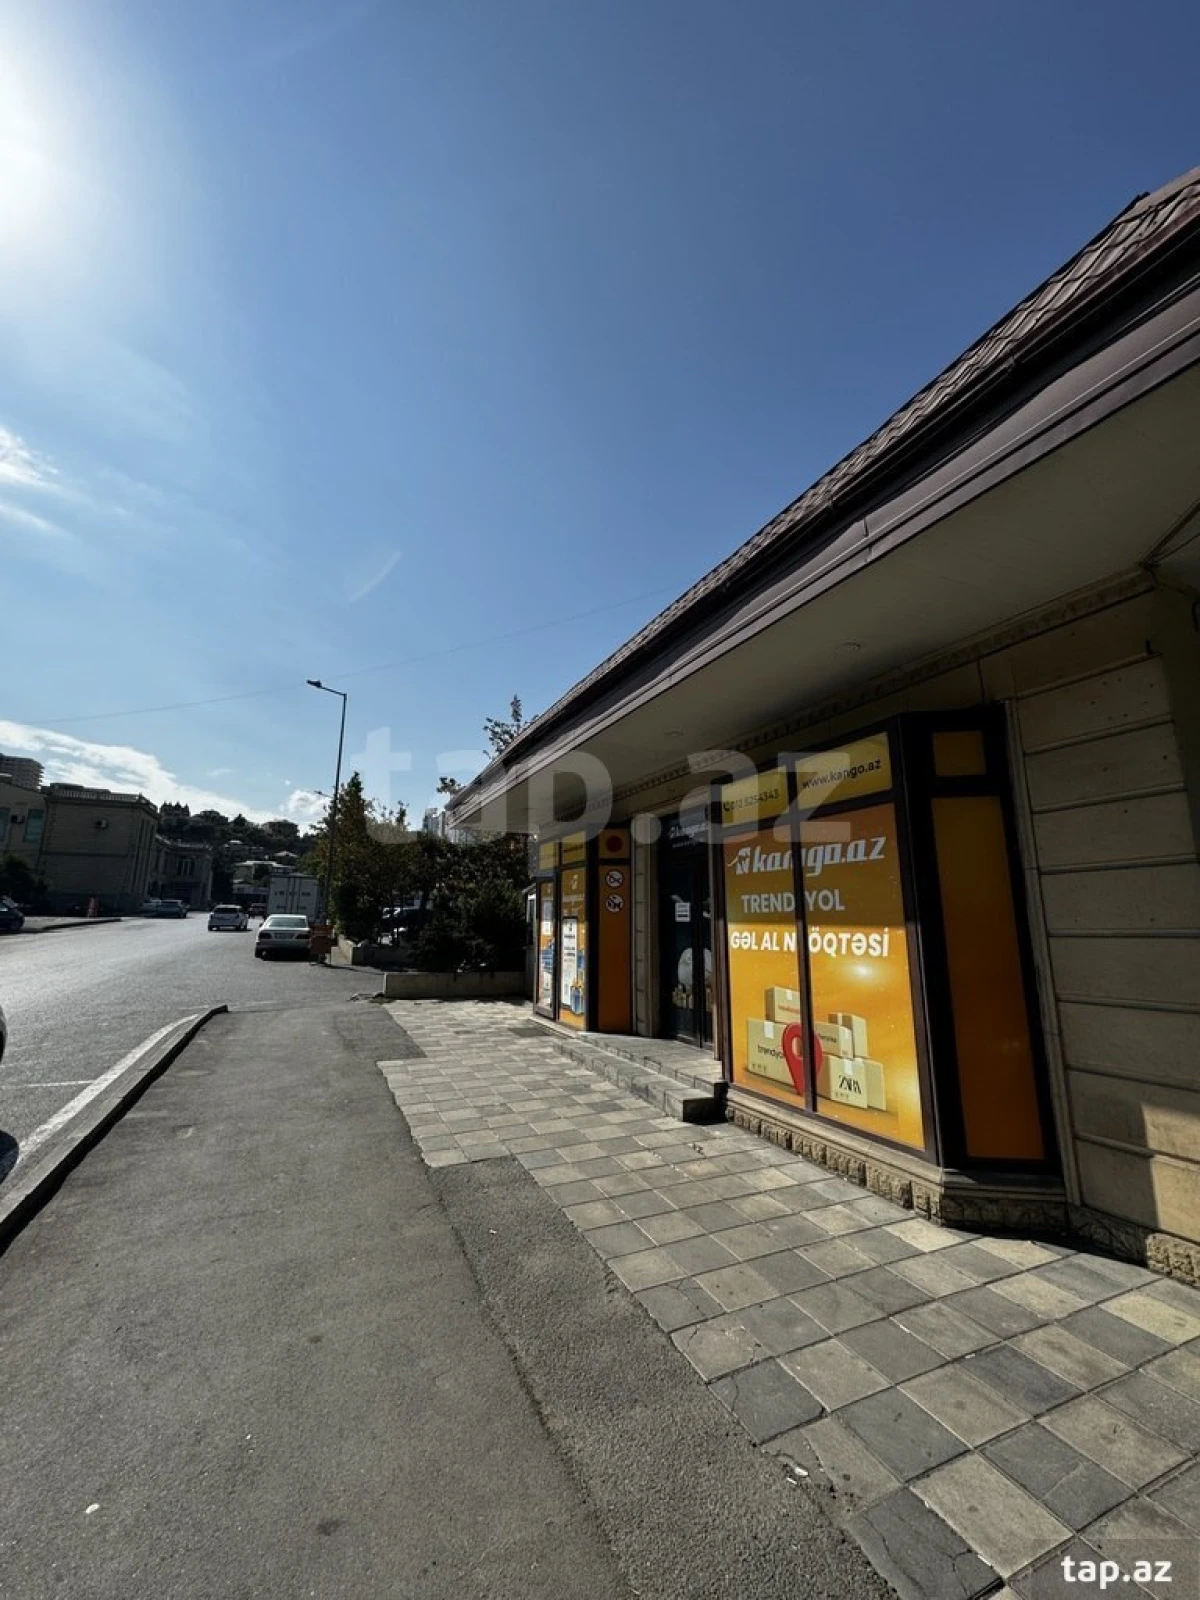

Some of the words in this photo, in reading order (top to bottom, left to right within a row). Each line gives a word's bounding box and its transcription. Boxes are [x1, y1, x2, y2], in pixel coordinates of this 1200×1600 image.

[801, 759, 882, 789] www.kango.az
[741, 888, 846, 913] TRENDYOL
[730, 930, 758, 950] GƏL
[760, 930, 780, 951] AL
[757, 1044, 784, 1060] trendyo
